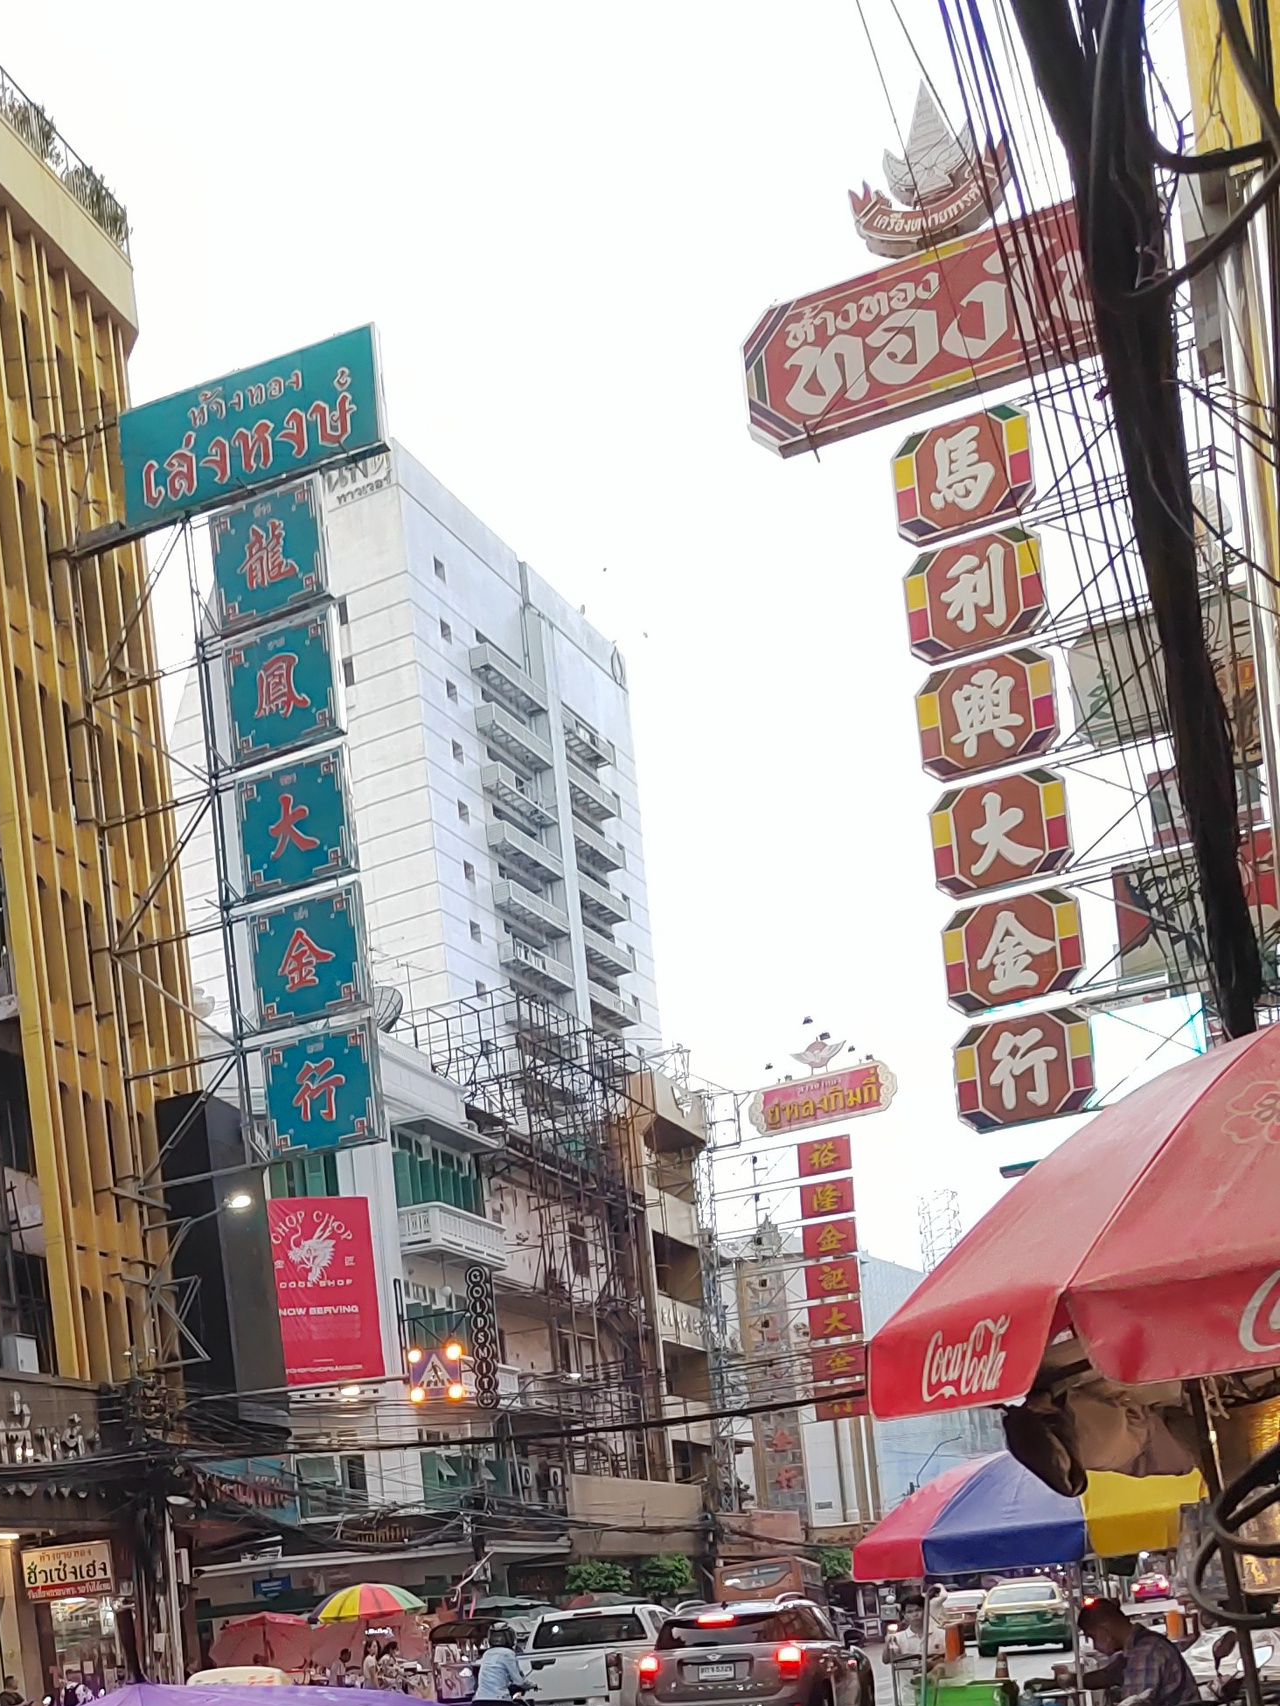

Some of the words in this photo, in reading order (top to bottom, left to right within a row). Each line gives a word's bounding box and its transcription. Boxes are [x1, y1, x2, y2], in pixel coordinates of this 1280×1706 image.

[785, 271, 941, 350] ห้างทอง
[188, 368, 304, 428] ห้างทอง
[142, 365, 357, 509] เล่งหงษ์
[271, 1210, 305, 1244] CHOP
[313, 1210, 353, 1240] CHOP
[279, 1307, 307, 1316] NOW
[309, 1305, 359, 1315] SERVING
[922, 1314, 1011, 1403] Coca-Cola
[27, 1560, 108, 1585] ฮั่วเซ่งเฮง
